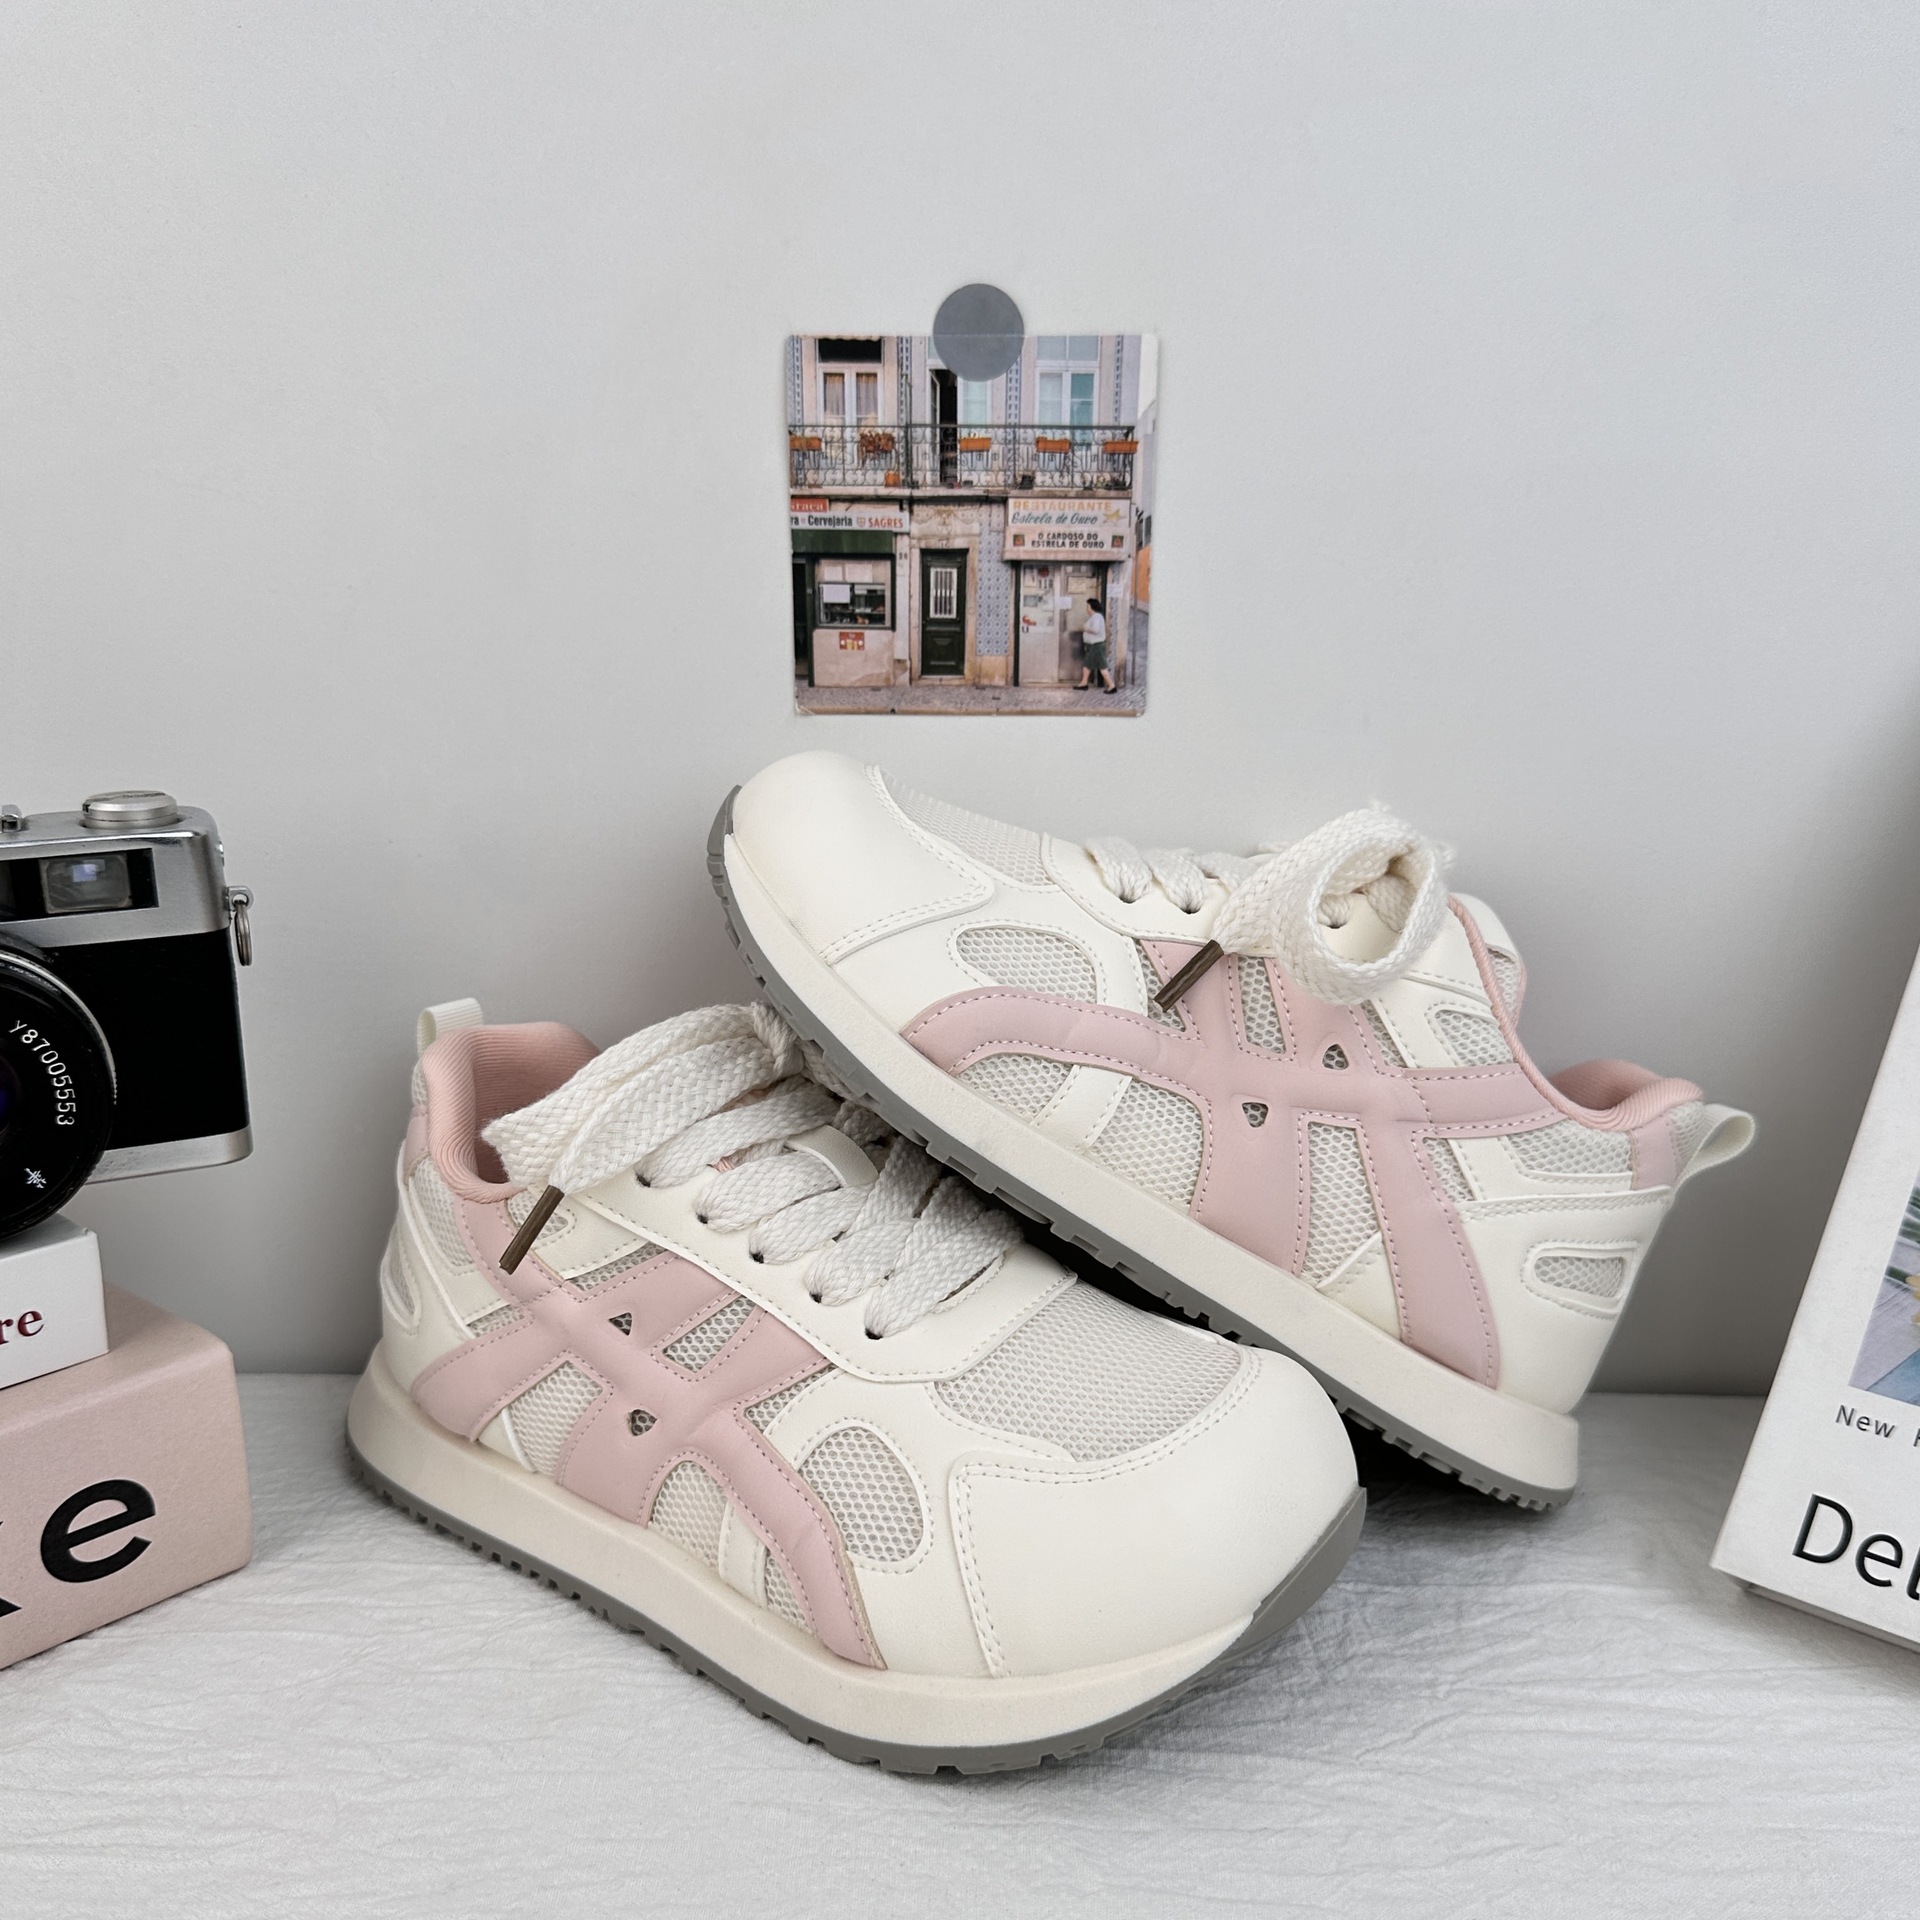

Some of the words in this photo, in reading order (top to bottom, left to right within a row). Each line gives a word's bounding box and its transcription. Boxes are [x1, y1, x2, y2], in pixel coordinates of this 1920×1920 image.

[1013, 501, 1112, 511] RESTAURANTE
[808, 515, 853, 528] Cervejaria
[868, 518, 903, 528] SAGRES
[1011, 512, 1051, 524] Estrela
[1055, 512, 1066, 524] de
[1070, 512, 1098, 524] Ouro
[1031, 540, 1066, 548] ESTRELA
[8, 1020, 77, 1126] Y87005553
[1835, 1404, 1896, 1438] New
